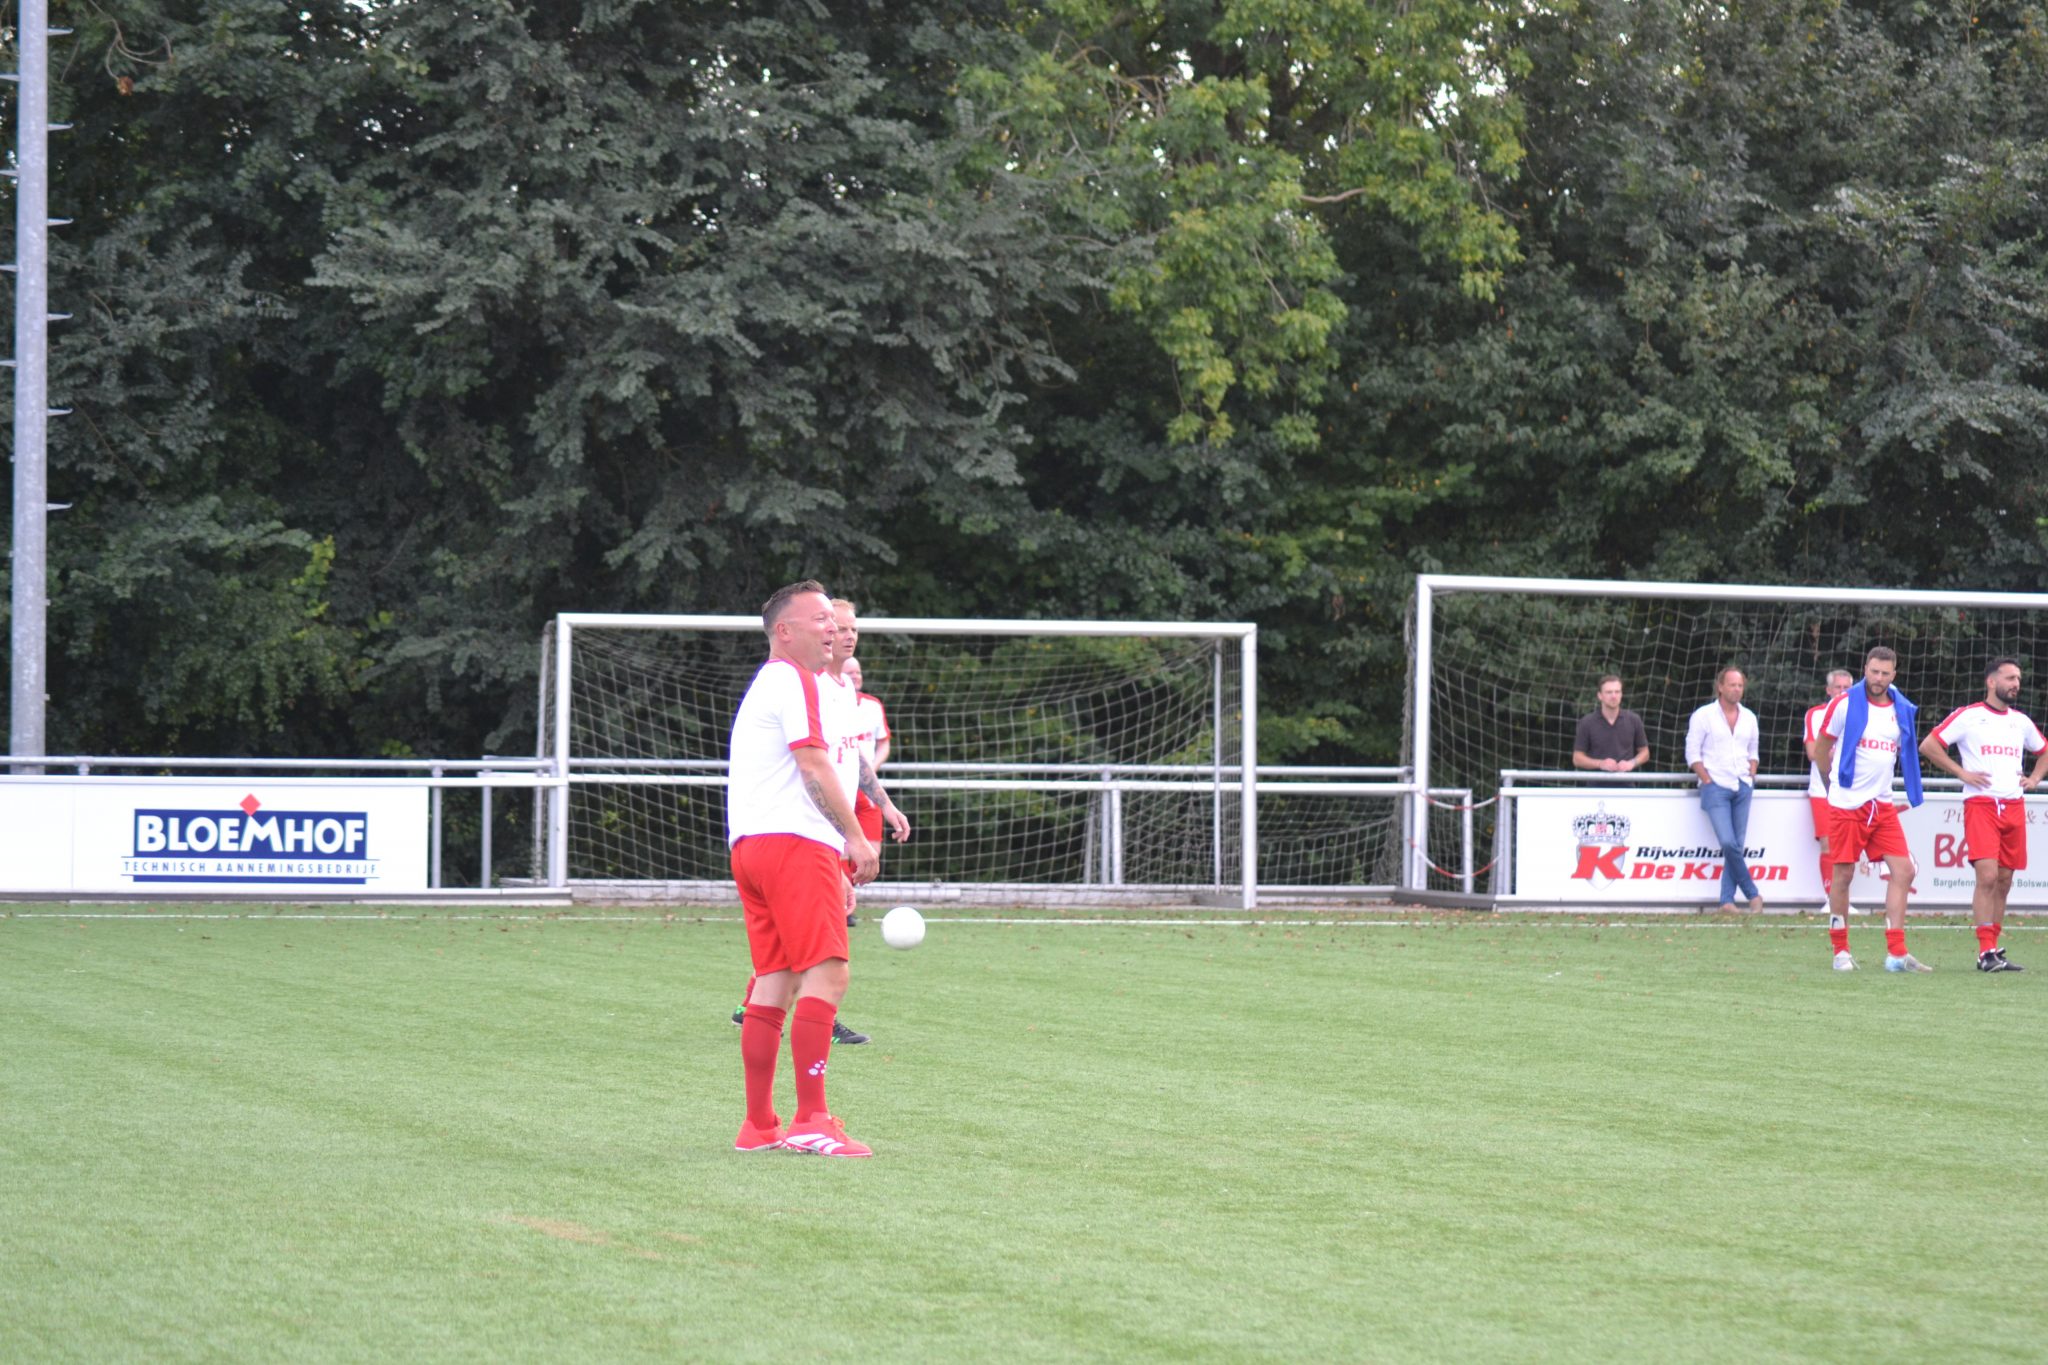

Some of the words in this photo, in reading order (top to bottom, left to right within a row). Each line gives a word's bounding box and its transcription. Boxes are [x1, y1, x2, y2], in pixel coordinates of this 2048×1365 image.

[137, 815, 365, 853] BLOEMHOF
[124, 861, 206, 872] TECHNISCH
[216, 862, 377, 874] AANNEMINGSBEDRIJF
[1571, 846, 1630, 879] K
[1630, 862, 1675, 880] De
[1680, 862, 1789, 880] Kron
[1933, 878, 1976, 889] Bargefenn
[2017, 878, 2048, 889] Bolswa
